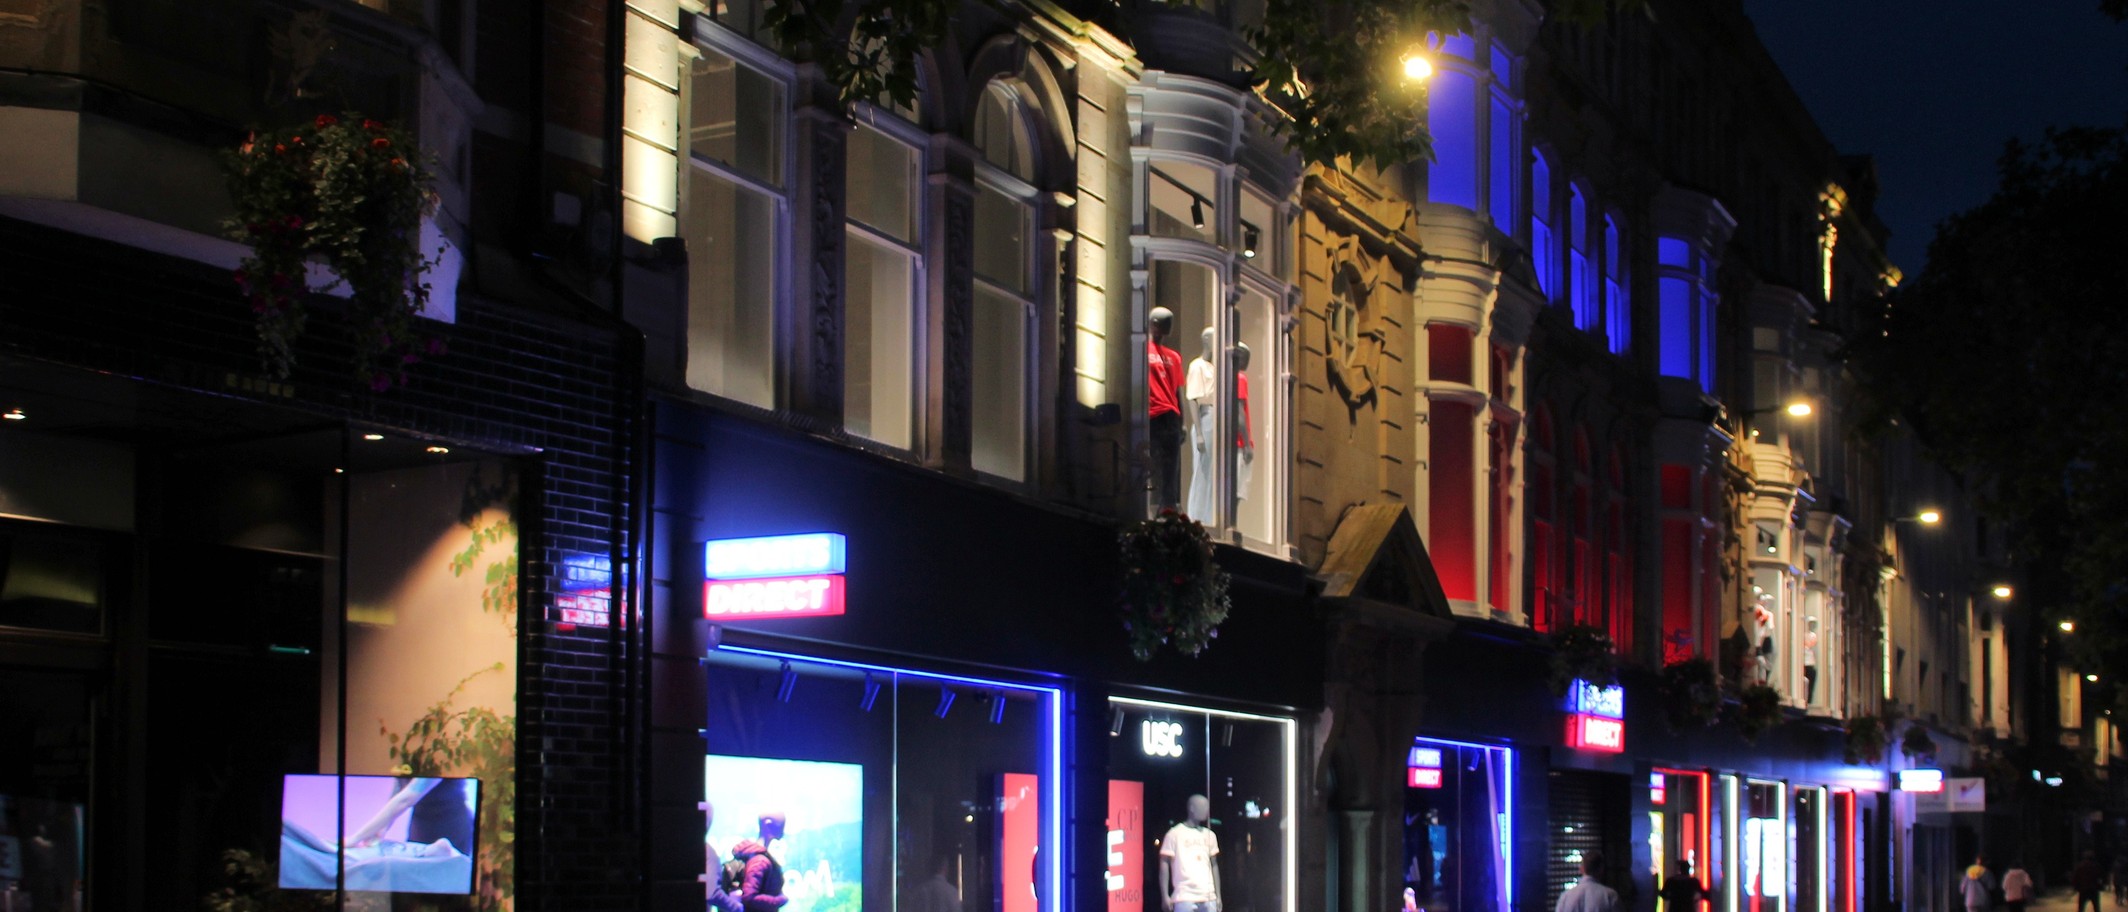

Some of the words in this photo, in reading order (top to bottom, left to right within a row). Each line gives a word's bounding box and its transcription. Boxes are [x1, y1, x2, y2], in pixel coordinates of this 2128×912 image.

[707, 579, 831, 614] DIRECT
[1142, 720, 1183, 757] USC
[1585, 717, 1622, 748] DIRECT
[1114, 889, 1140, 902] HUGO
